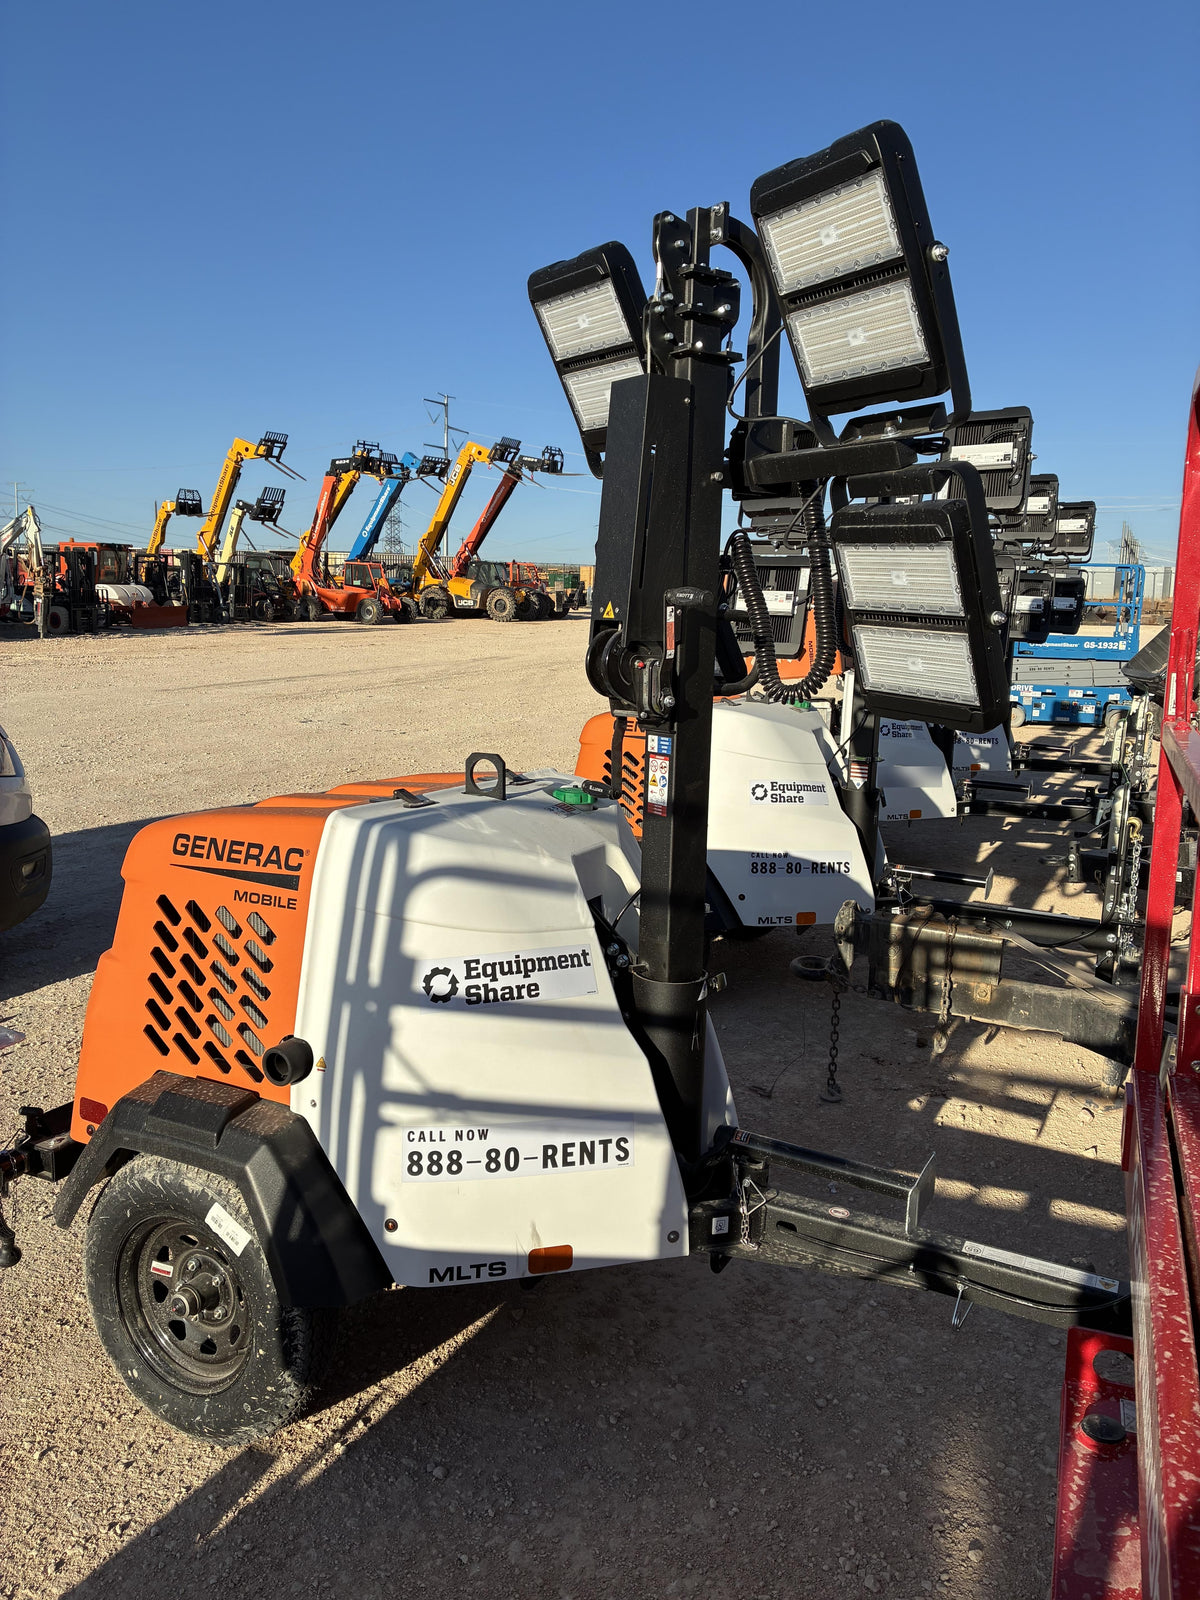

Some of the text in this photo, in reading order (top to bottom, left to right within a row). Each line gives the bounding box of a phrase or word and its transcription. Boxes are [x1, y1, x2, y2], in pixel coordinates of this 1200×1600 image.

[449, 463, 462, 487] JCB
[1083, 641, 1119, 650] GS-1932
[891, 723, 924, 731] Equipment
[770, 781, 826, 793] Equipment
[770, 793, 804, 803] Share
[233, 889, 298, 910] MOBILE
[757, 916, 793, 925] MLTS
[463, 948, 592, 981] Equipment
[464, 981, 540, 1006] Share
[407, 1128, 489, 1143] CALL NOW
[406, 1136, 630, 1177] 888-80-RENTS
[428, 1261, 507, 1284] MLTS
